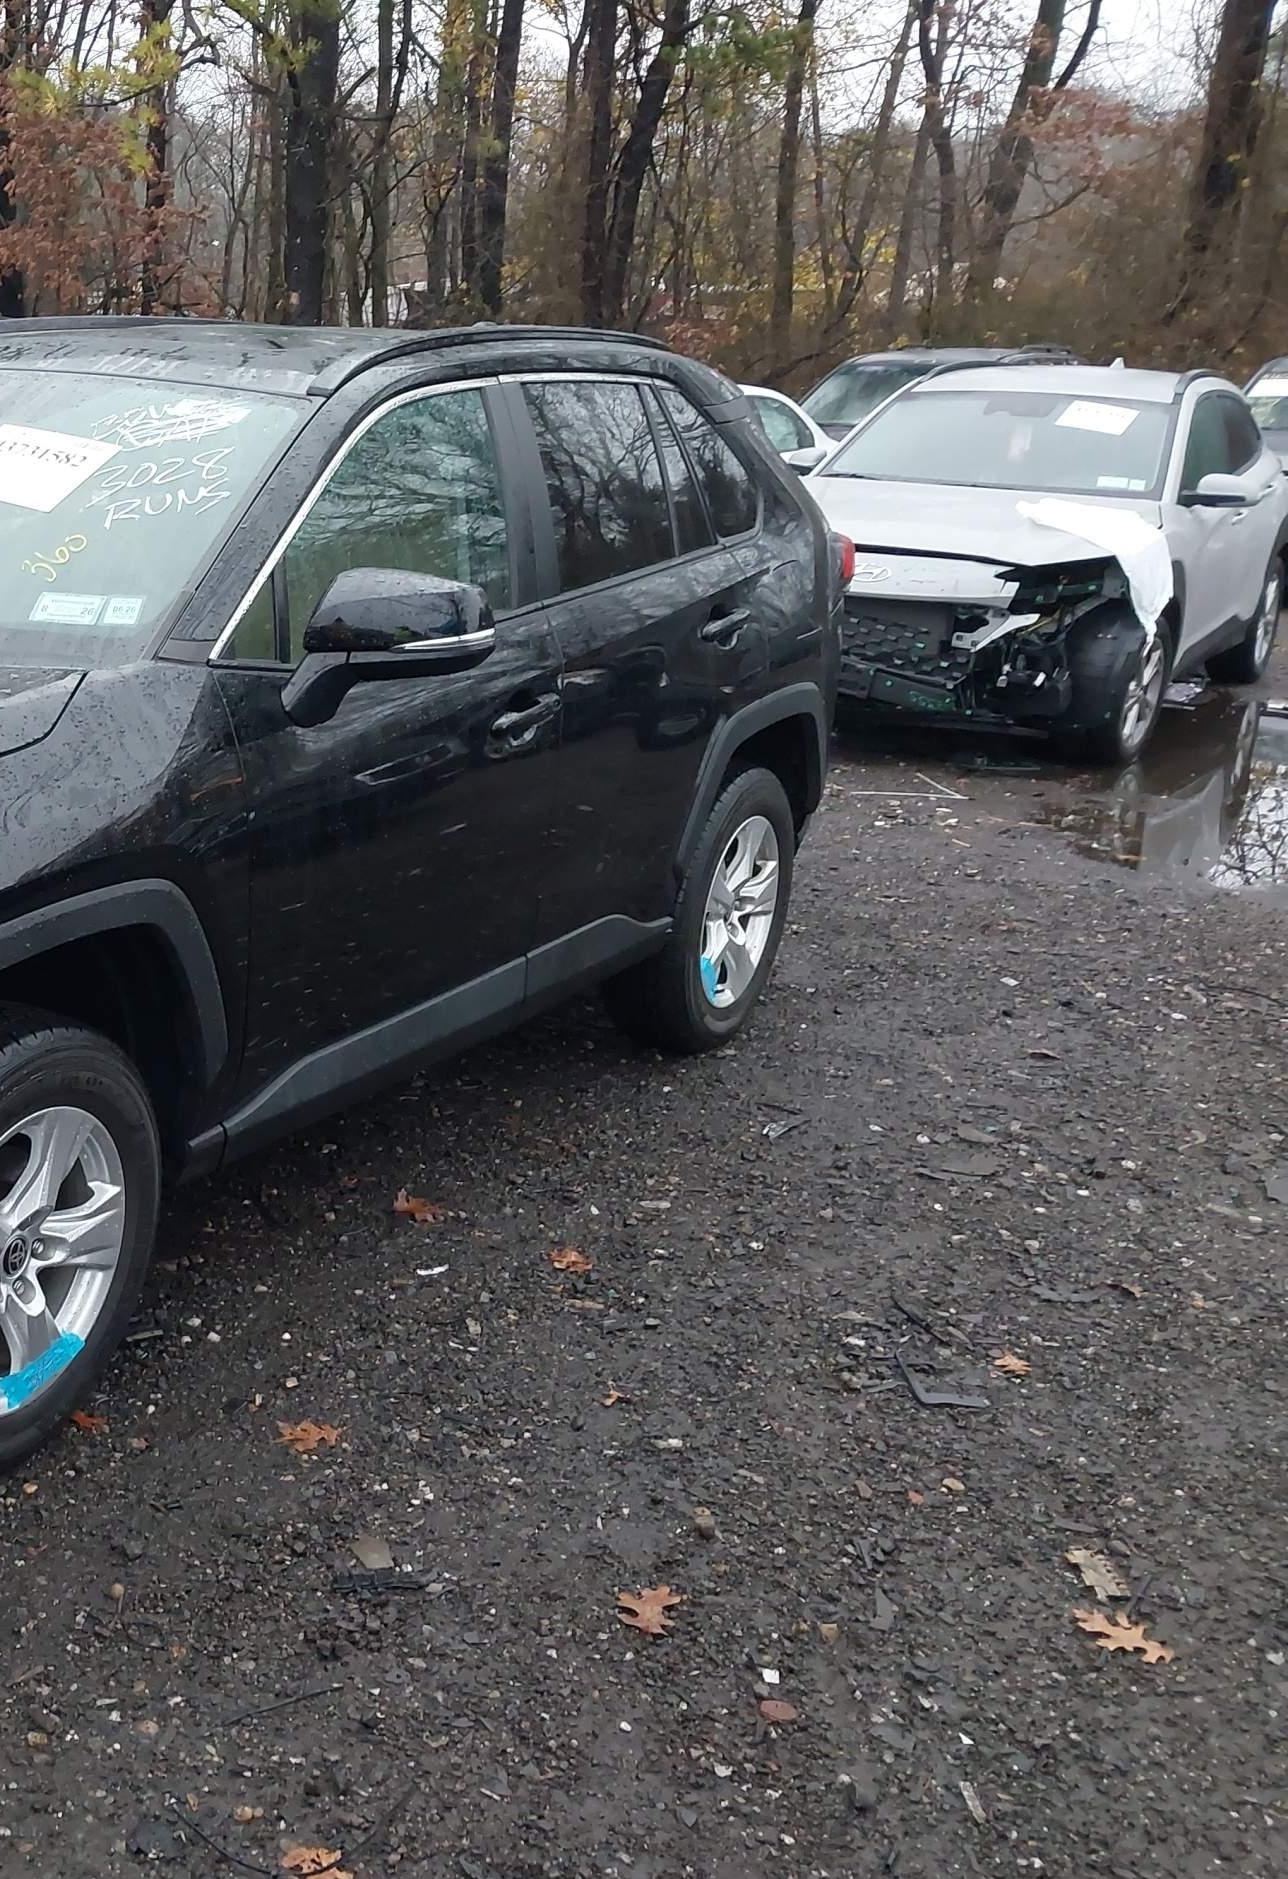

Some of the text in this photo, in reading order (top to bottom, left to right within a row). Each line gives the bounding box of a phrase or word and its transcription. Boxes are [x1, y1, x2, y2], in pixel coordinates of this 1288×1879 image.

[85, 446, 237, 508] 3028
[103, 477, 232, 531] RUNS
[21, 534, 88, 583] 360
